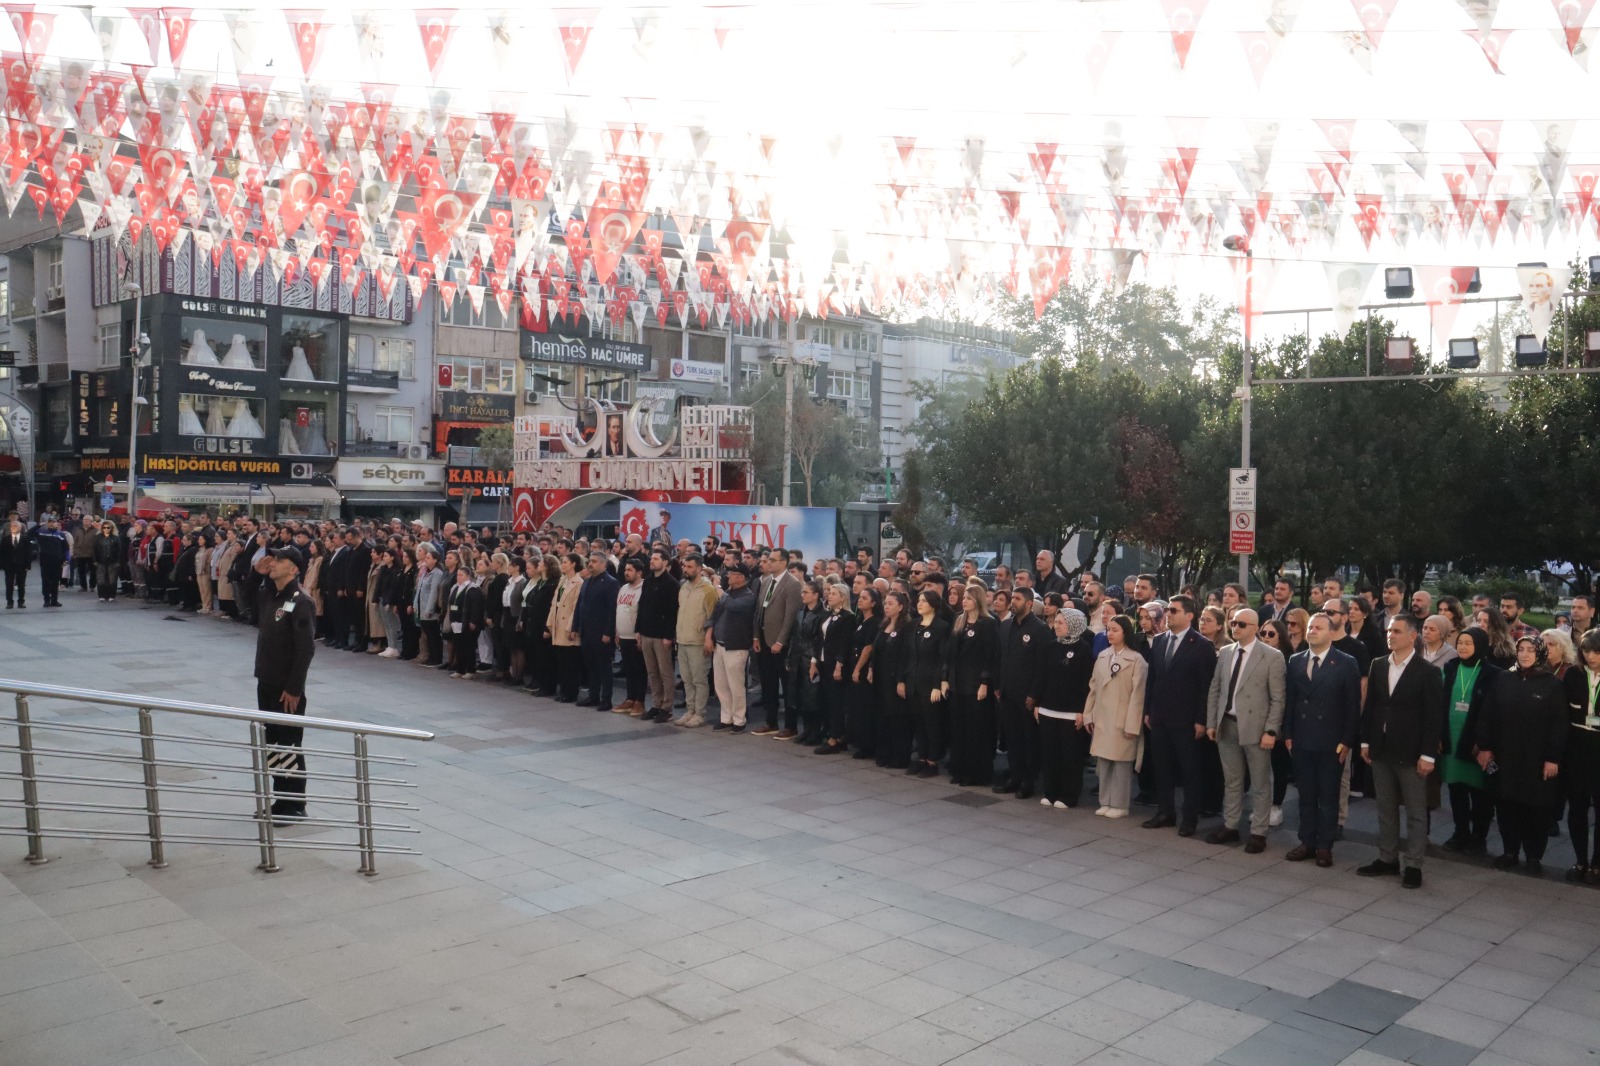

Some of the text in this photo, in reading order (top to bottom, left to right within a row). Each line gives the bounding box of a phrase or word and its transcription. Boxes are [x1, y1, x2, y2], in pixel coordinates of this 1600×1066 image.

[591, 347, 645, 366] HAC UMRE
[470, 406, 510, 418] HAYALLER
[148, 456, 281, 473] HAS DÖRTLER YUFKA
[482, 486, 510, 497] CAFE
[707, 512, 789, 549] EKİM
